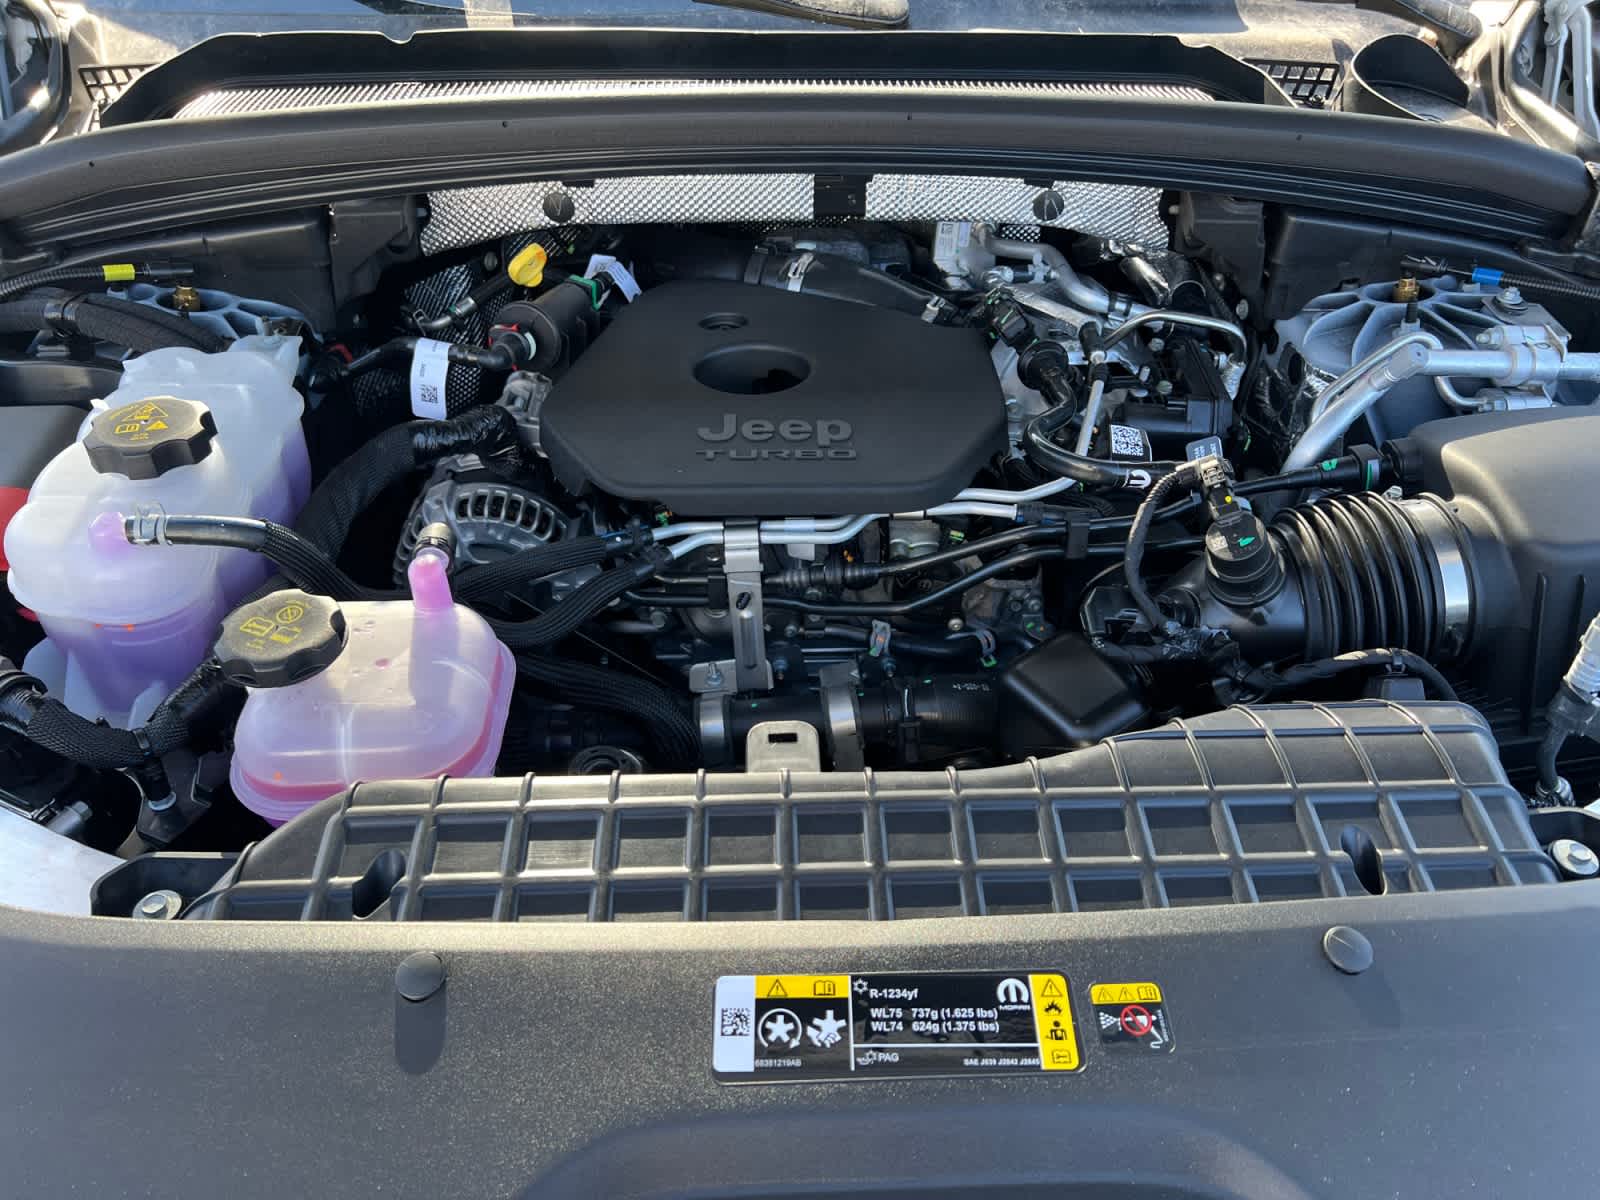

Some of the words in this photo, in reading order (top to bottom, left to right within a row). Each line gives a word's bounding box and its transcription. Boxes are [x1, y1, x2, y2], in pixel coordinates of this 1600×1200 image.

[697, 413, 852, 447] Jeep
[696, 449, 857, 461] TURBO
[869, 988, 919, 1001] R-1234yf
[870, 1008, 903, 1019] WL75
[911, 1008, 938, 1020] 737g
[940, 1007, 975, 1020] (1.625
[976, 1007, 998, 1020] lbs)
[871, 1021, 904, 1032] WL74
[912, 1022, 940, 1034] 624g
[942, 1021, 976, 1033] (1.375
[978, 1020, 1000, 1033] lbs)
[878, 1052, 899, 1062] PAG
